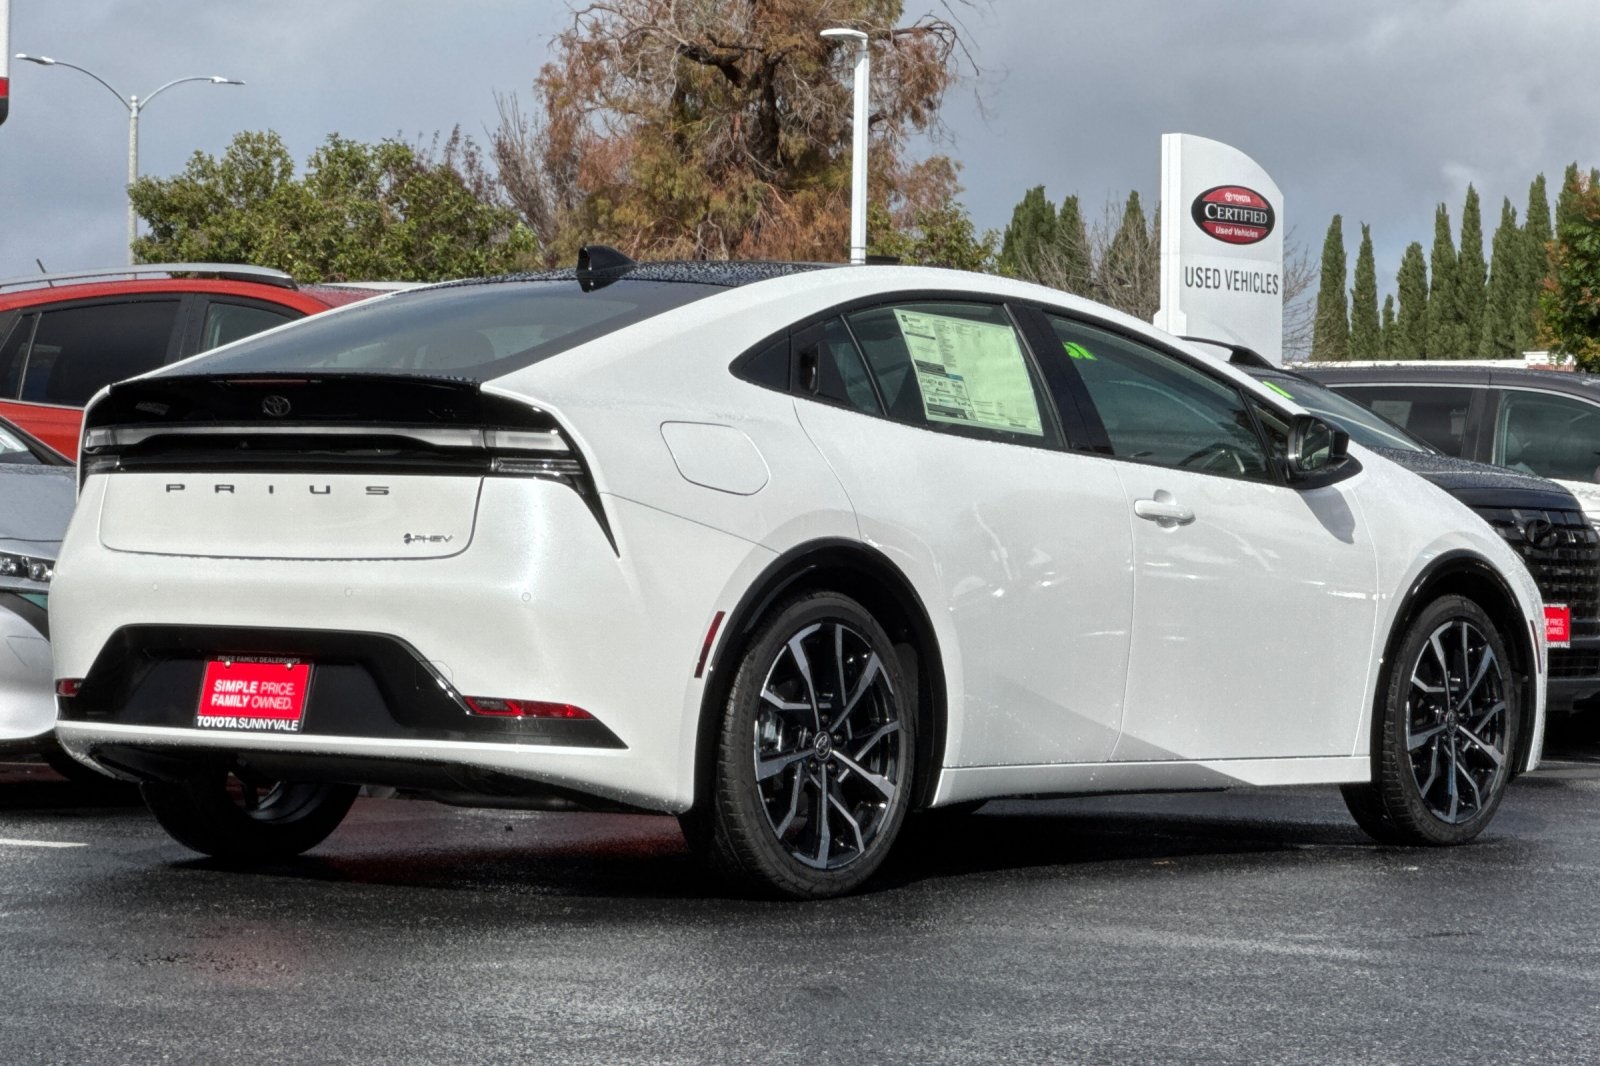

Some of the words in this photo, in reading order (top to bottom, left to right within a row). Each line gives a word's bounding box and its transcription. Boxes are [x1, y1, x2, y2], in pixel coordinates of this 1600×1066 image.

[1233, 193, 1251, 203] TOYOTA
[1204, 203, 1268, 224] CERTIFIED
[1215, 226, 1233, 235] Used
[1234, 227, 1258, 238] Vehicles
[1185, 266, 1221, 289] USED
[1224, 269, 1279, 295] VEHICLES
[165, 483, 390, 496] PRIUS
[413, 534, 453, 544] PHEV
[214, 679, 258, 693] SIMPLE
[260, 681, 295, 696] PRICE.
[211, 694, 250, 708] FAMILY
[251, 695, 293, 710] OWNED.
